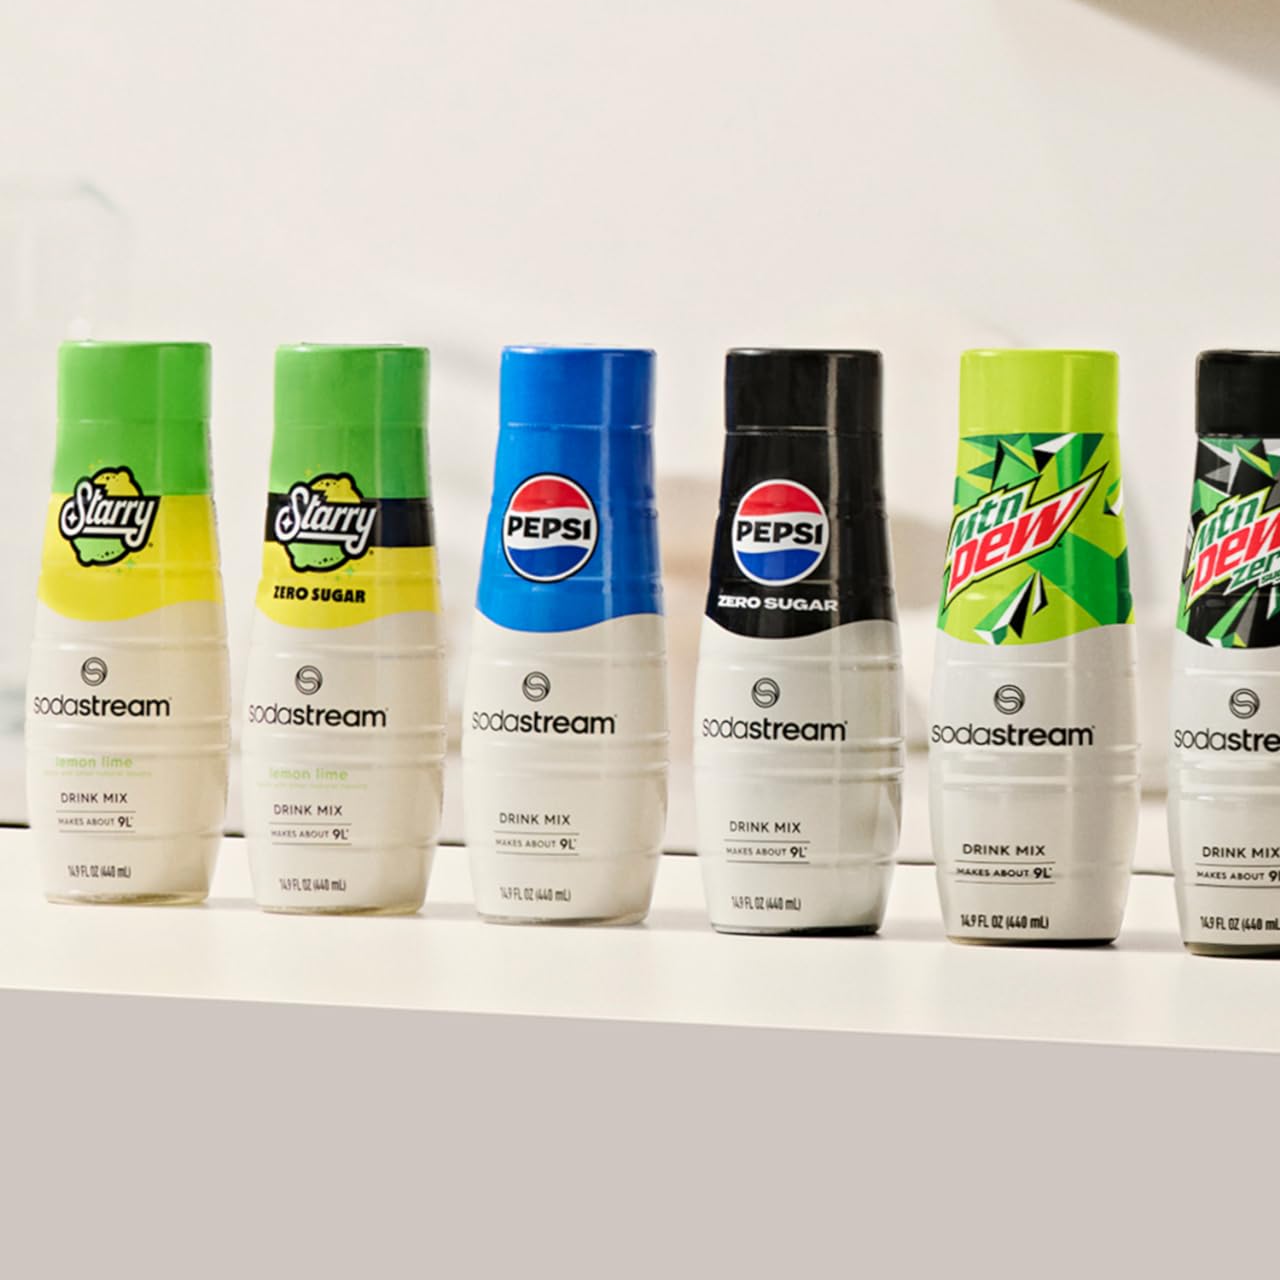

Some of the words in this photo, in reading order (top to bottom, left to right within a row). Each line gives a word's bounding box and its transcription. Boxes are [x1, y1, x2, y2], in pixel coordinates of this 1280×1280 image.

[60, 479, 156, 548] Starry
[274, 485, 377, 556] Starry
[507, 515, 592, 540] PEPSI
[736, 520, 824, 545] PEPSI
[273, 585, 309, 601] ZERO
[312, 586, 366, 603] SUGAR
[717, 594, 762, 609] ZERO
[764, 596, 839, 612] SUGAR
[33, 694, 171, 718] sodastream
[249, 703, 387, 728] sodastream
[472, 709, 616, 735] sodastream
[702, 716, 847, 742] sodastream
[931, 723, 1094, 747] sodastream
[55, 755, 97, 769] lemon
[101, 755, 134, 769] lime
[60, 792, 99, 804] DRINK
[103, 792, 128, 804] MIX
[273, 803, 313, 816] DRINK
[316, 804, 343, 816] MIX
[58, 817, 84, 826] MAKES
[86, 817, 114, 826] ABOUT
[499, 812, 540, 825] DRINK
[543, 813, 571, 826] MIX
[729, 820, 770, 833] DRINK
[774, 821, 801, 834] MIX
[271, 830, 297, 838] MAKES
[299, 830, 329, 839] ABOUT
[495, 839, 523, 848] MAKES
[525, 839, 556, 849] ABOUT
[962, 843, 1010, 855] DRINK
[1015, 845, 1046, 856] MIX
[726, 847, 753, 856] MAKES
[755, 847, 787, 857] ABOUT
[1202, 846, 1247, 859] DRINK
[1251, 847, 1280, 859] MIX
[956, 867, 990, 877] MAKES
[993, 868, 1030, 878] ABOUT
[1196, 871, 1228, 880] MAKES
[1229, 872, 1265, 881] ABOUT
